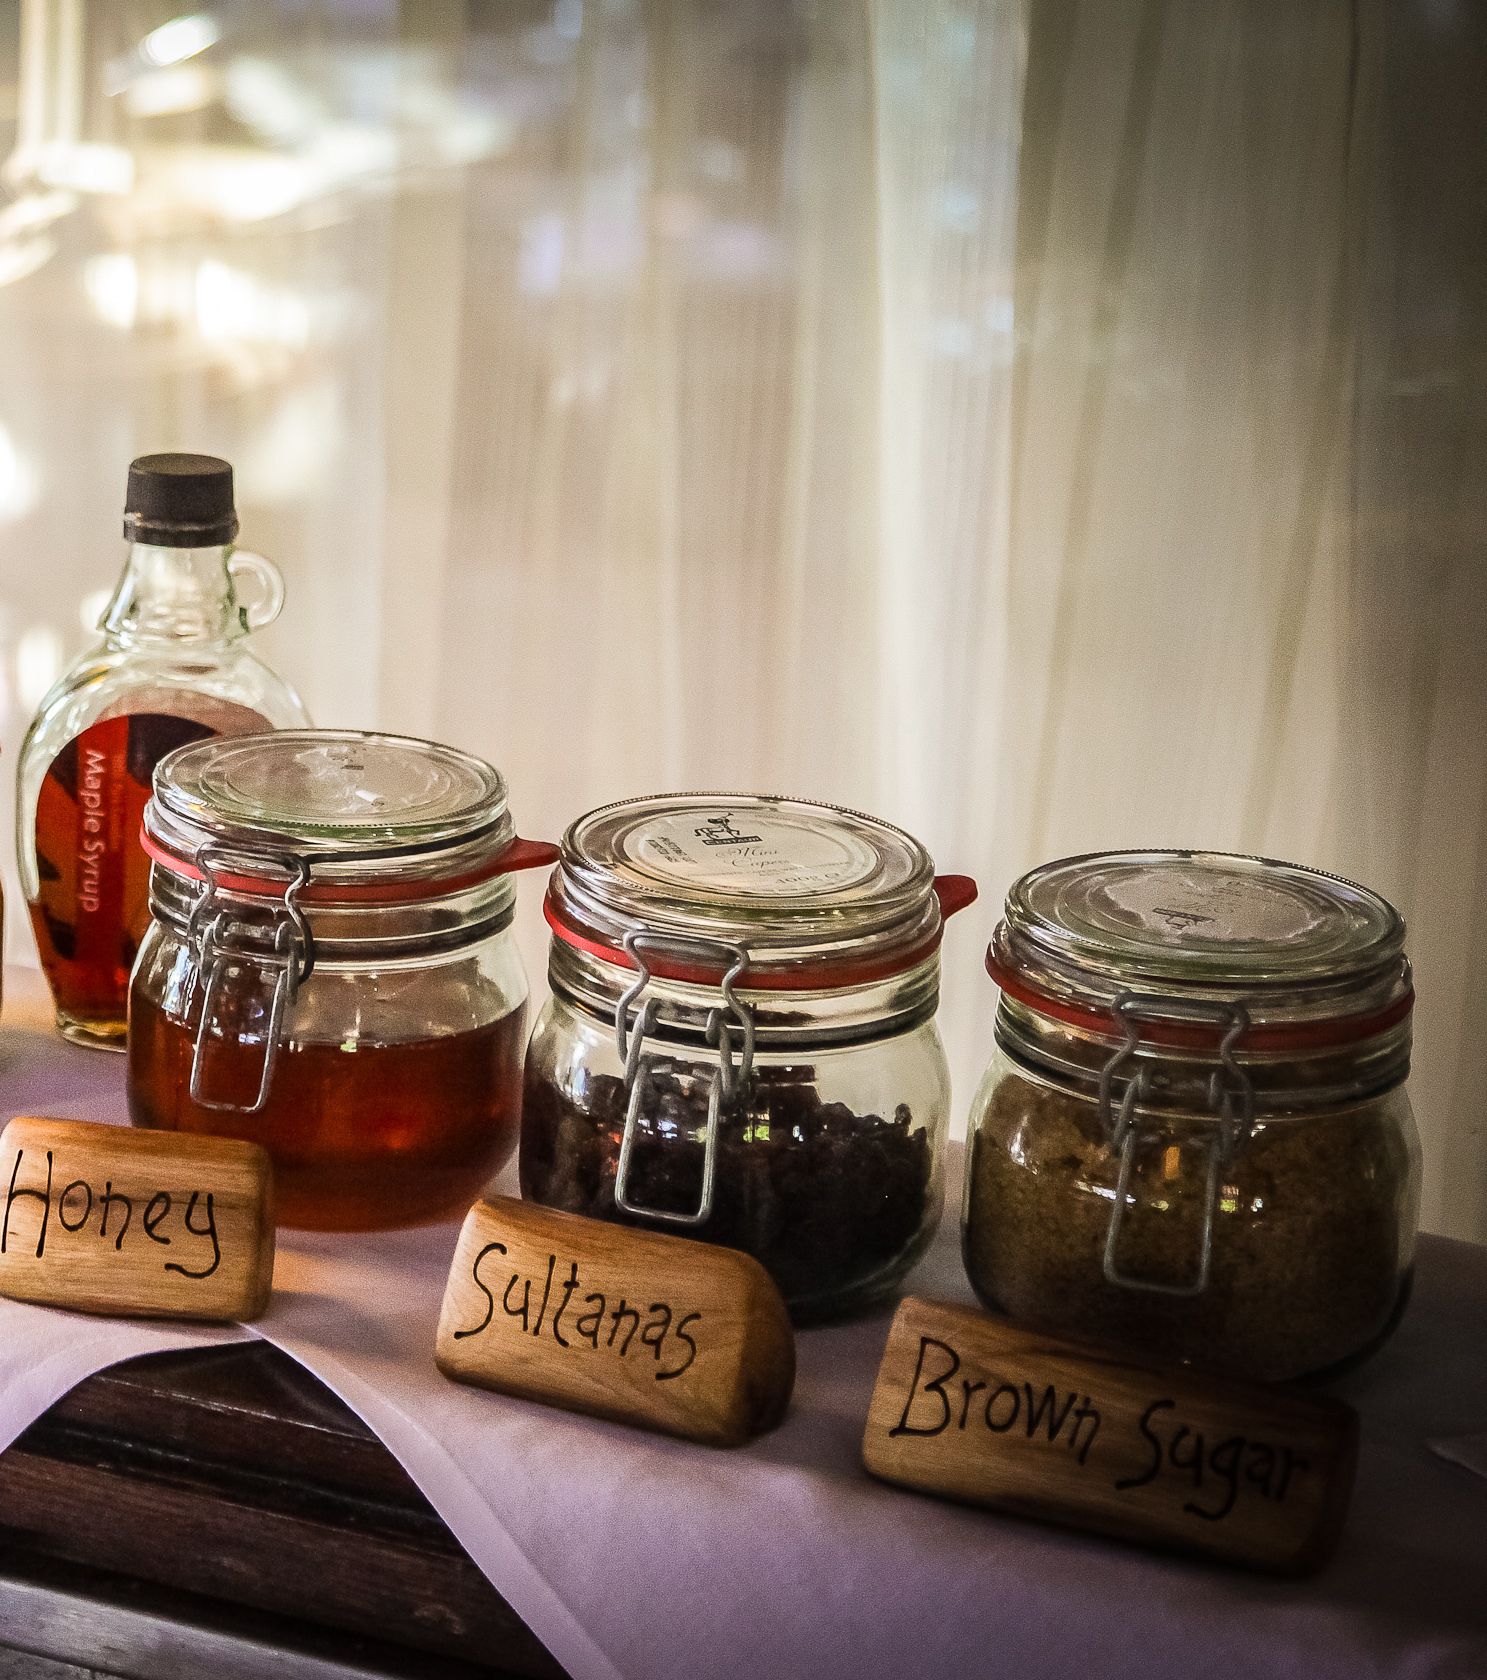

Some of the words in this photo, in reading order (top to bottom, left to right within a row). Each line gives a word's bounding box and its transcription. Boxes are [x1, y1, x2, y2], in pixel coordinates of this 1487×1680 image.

[79, 750, 107, 832] Maple
[79, 834, 106, 913] Syrup
[0, 1148, 223, 1280] Honey
[452, 1242, 702, 1381] Sultanas
[888, 1336, 1102, 1466] Brown
[1115, 1400, 1310, 1521] Sugar
